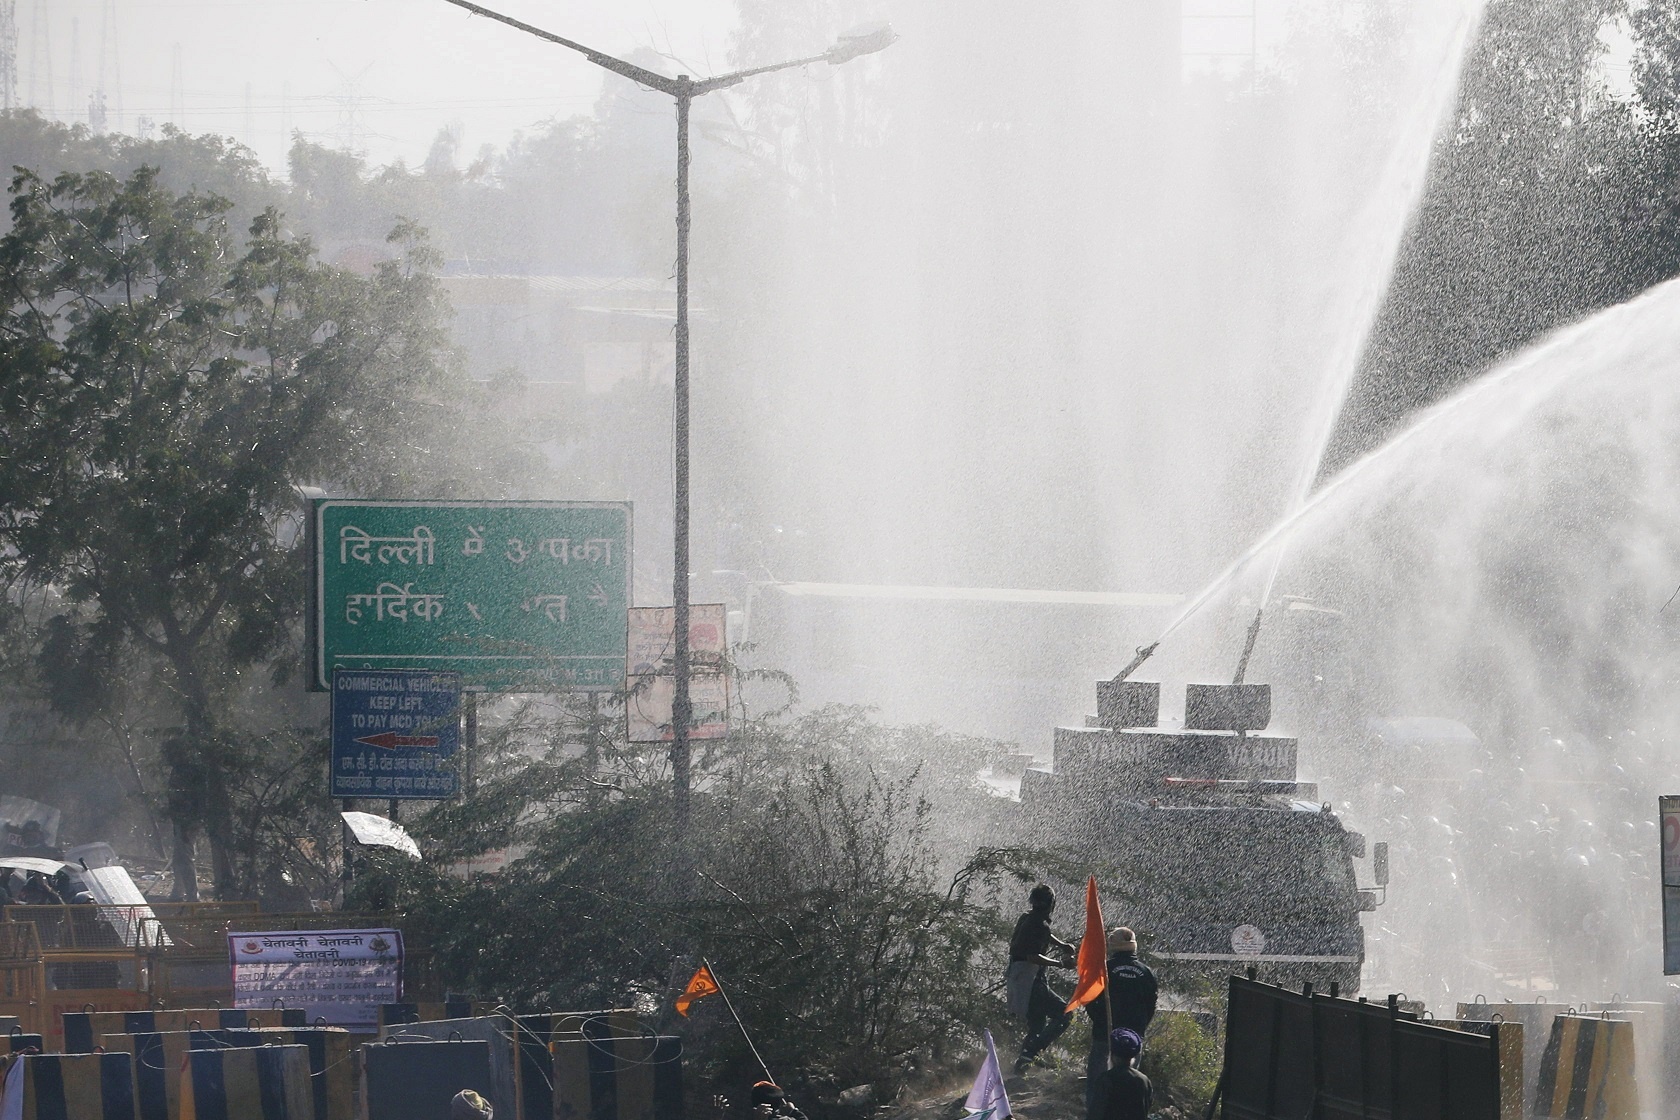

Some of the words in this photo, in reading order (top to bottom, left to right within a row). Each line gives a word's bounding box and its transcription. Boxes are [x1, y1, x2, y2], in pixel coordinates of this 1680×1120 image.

[339, 526, 436, 565] दिल्ली
[346, 582, 445, 625] हार्दिक
[338, 677, 404, 691] COMMERCIAL
[369, 696, 396, 709] KEEP
[399, 697, 422, 710] LEFT
[352, 714, 365, 727] TO
[368, 714, 388, 727] PAY
[390, 715, 412, 728] MCD
[262, 937, 309, 948] चेतावनी
[317, 936, 363, 946] चेतावनी
[293, 949, 340, 959] चेतावनी
[332, 958, 367, 967] COVID-19
